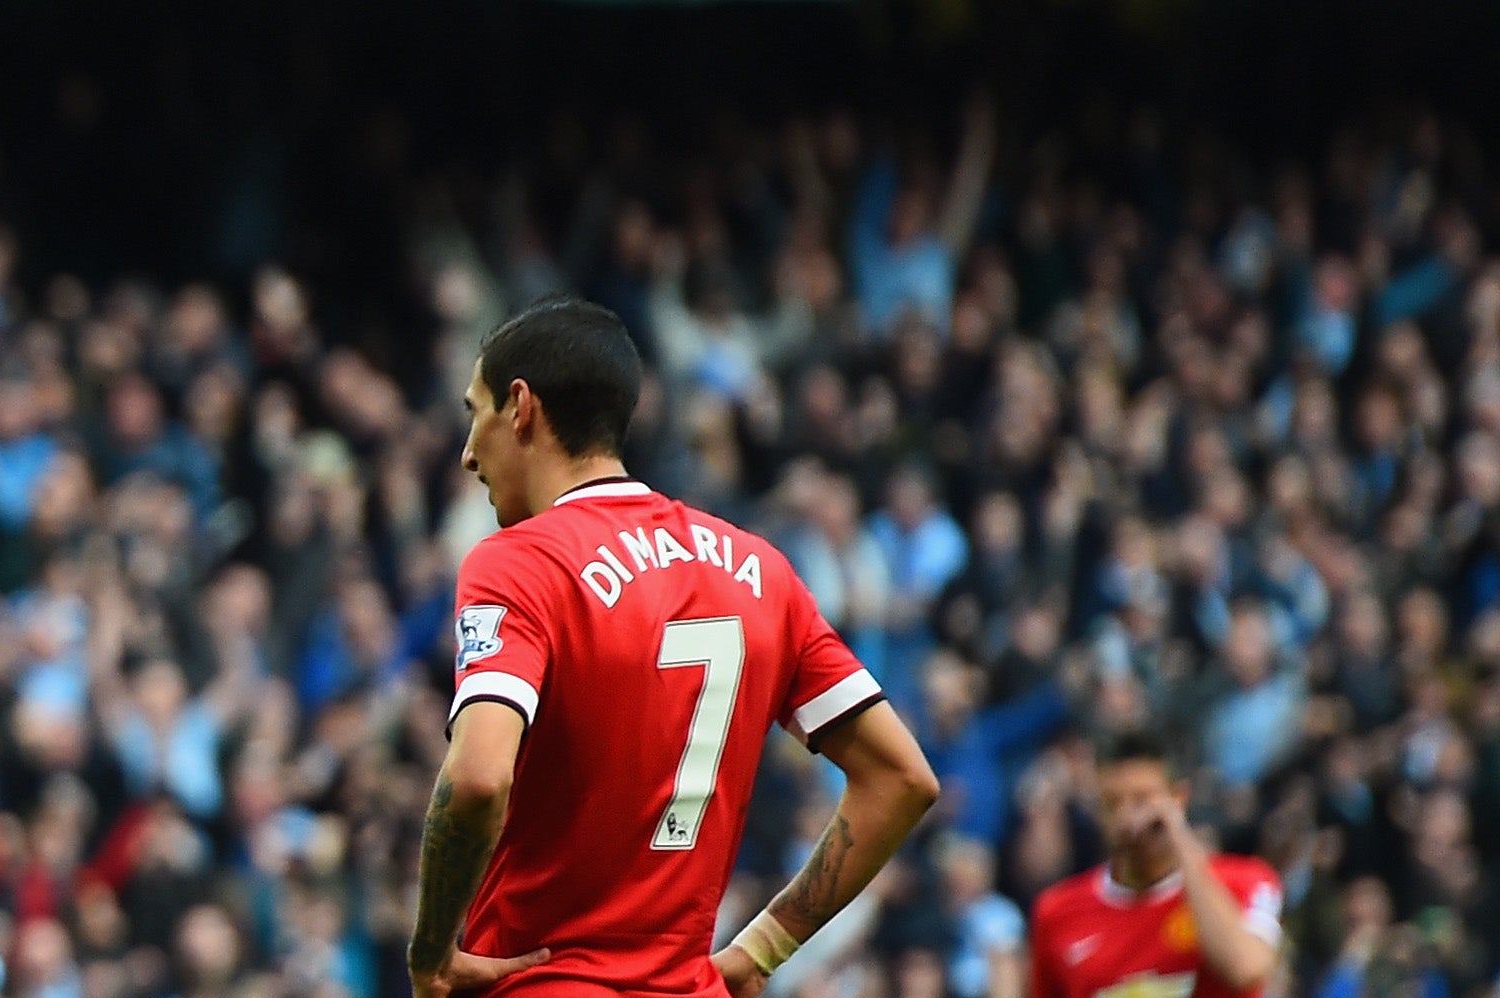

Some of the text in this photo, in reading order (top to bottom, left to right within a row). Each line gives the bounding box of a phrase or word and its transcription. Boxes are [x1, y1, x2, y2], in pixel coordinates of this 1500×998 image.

[580, 523, 762, 609] DI MARIA
[650, 616, 746, 850] 7
